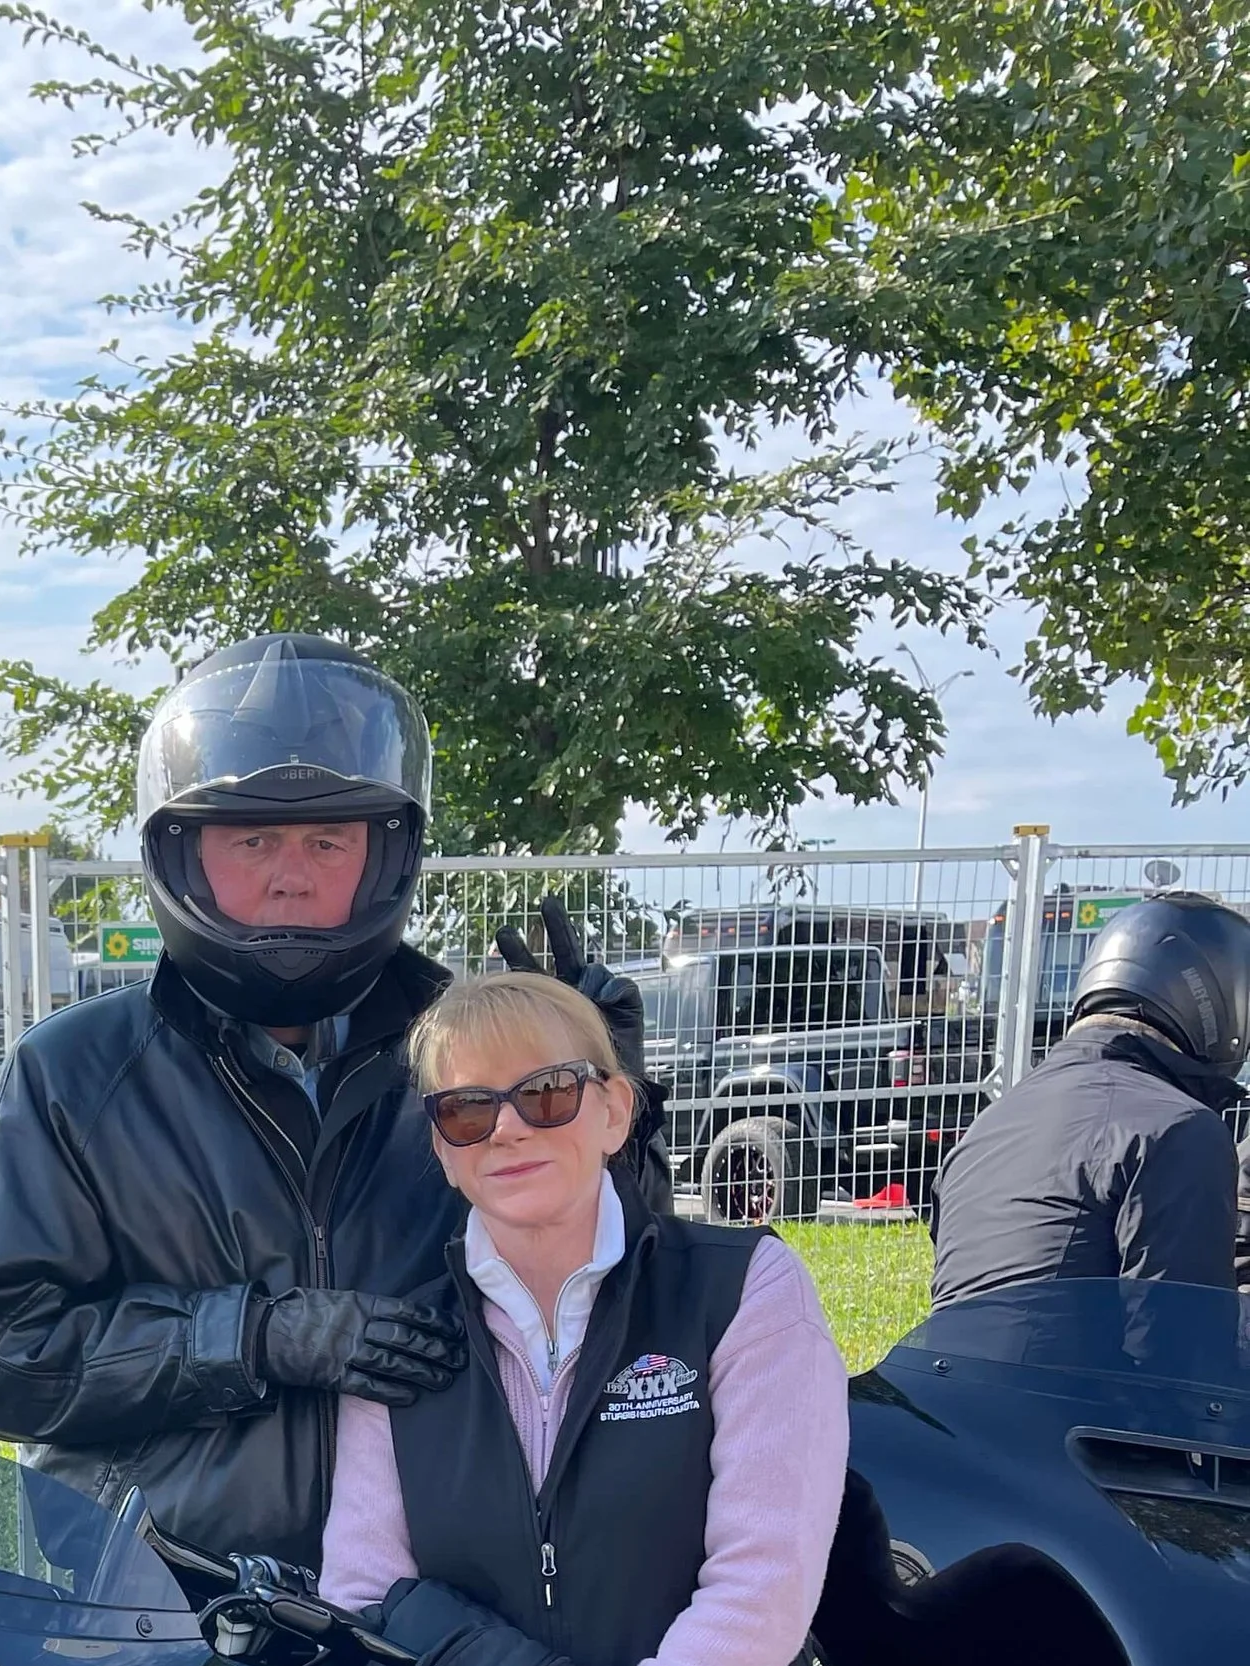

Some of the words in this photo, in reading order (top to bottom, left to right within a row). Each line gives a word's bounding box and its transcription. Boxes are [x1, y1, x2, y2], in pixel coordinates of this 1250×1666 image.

[627, 1370, 678, 1400] XXX
[600, 1411, 636, 1421] STURGIS
[640, 1407, 668, 1419] SOUTH
[668, 1400, 700, 1414] DAKOTA
[635, 1391, 694, 1411] ANNIVERSARY
